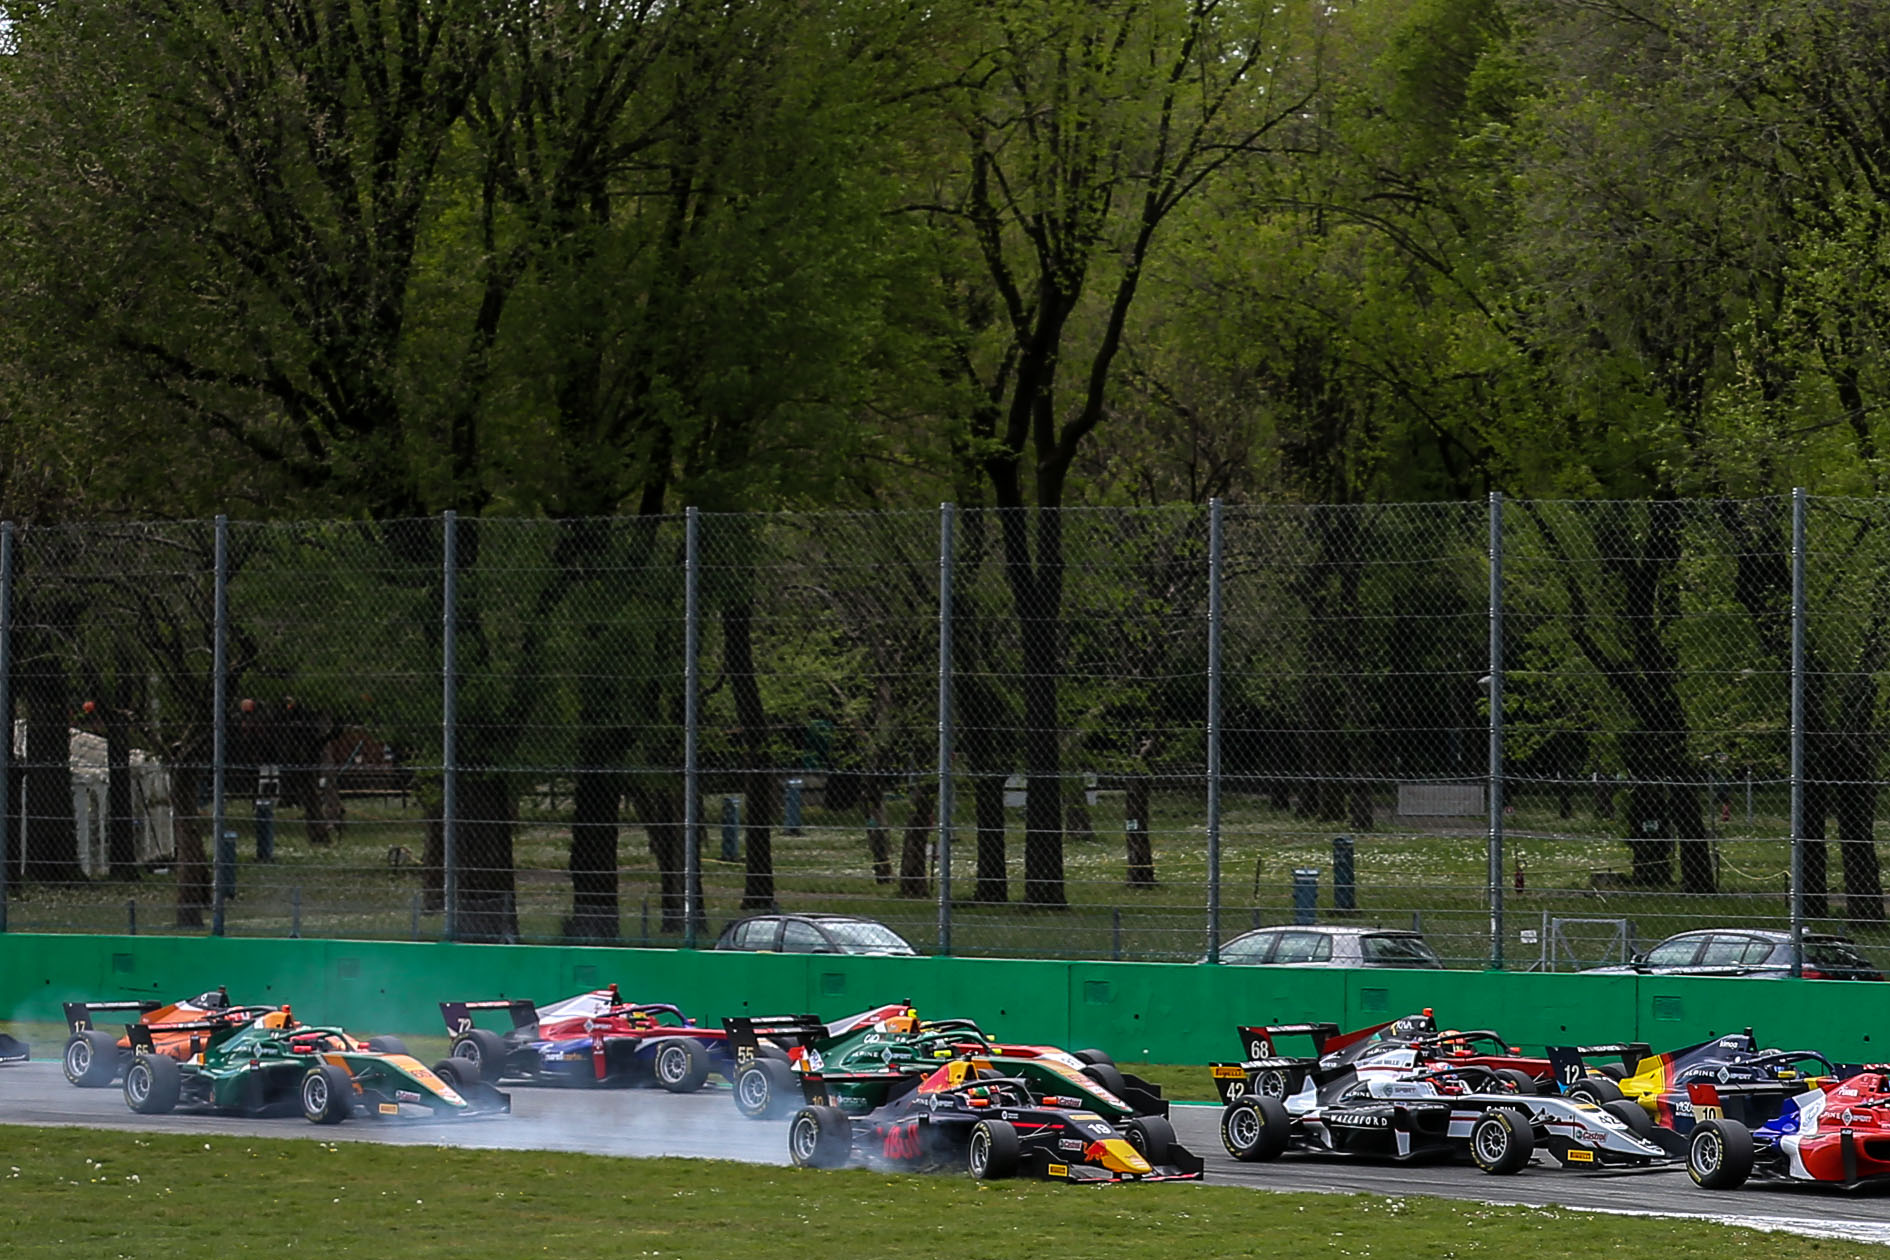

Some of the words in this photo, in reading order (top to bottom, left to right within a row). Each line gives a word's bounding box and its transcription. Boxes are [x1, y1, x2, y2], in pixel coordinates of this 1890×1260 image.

[457, 1018, 471, 1032] 72
[737, 1046, 754, 1064] 55
[1251, 1040, 1269, 1059] 68
[1564, 1064, 1580, 1085] 12
[1227, 1082, 1245, 1101] 42
[1702, 1107, 1716, 1121] 10
[1087, 1123, 1112, 1135] 19
[1582, 1131, 1607, 1142] Castrol
